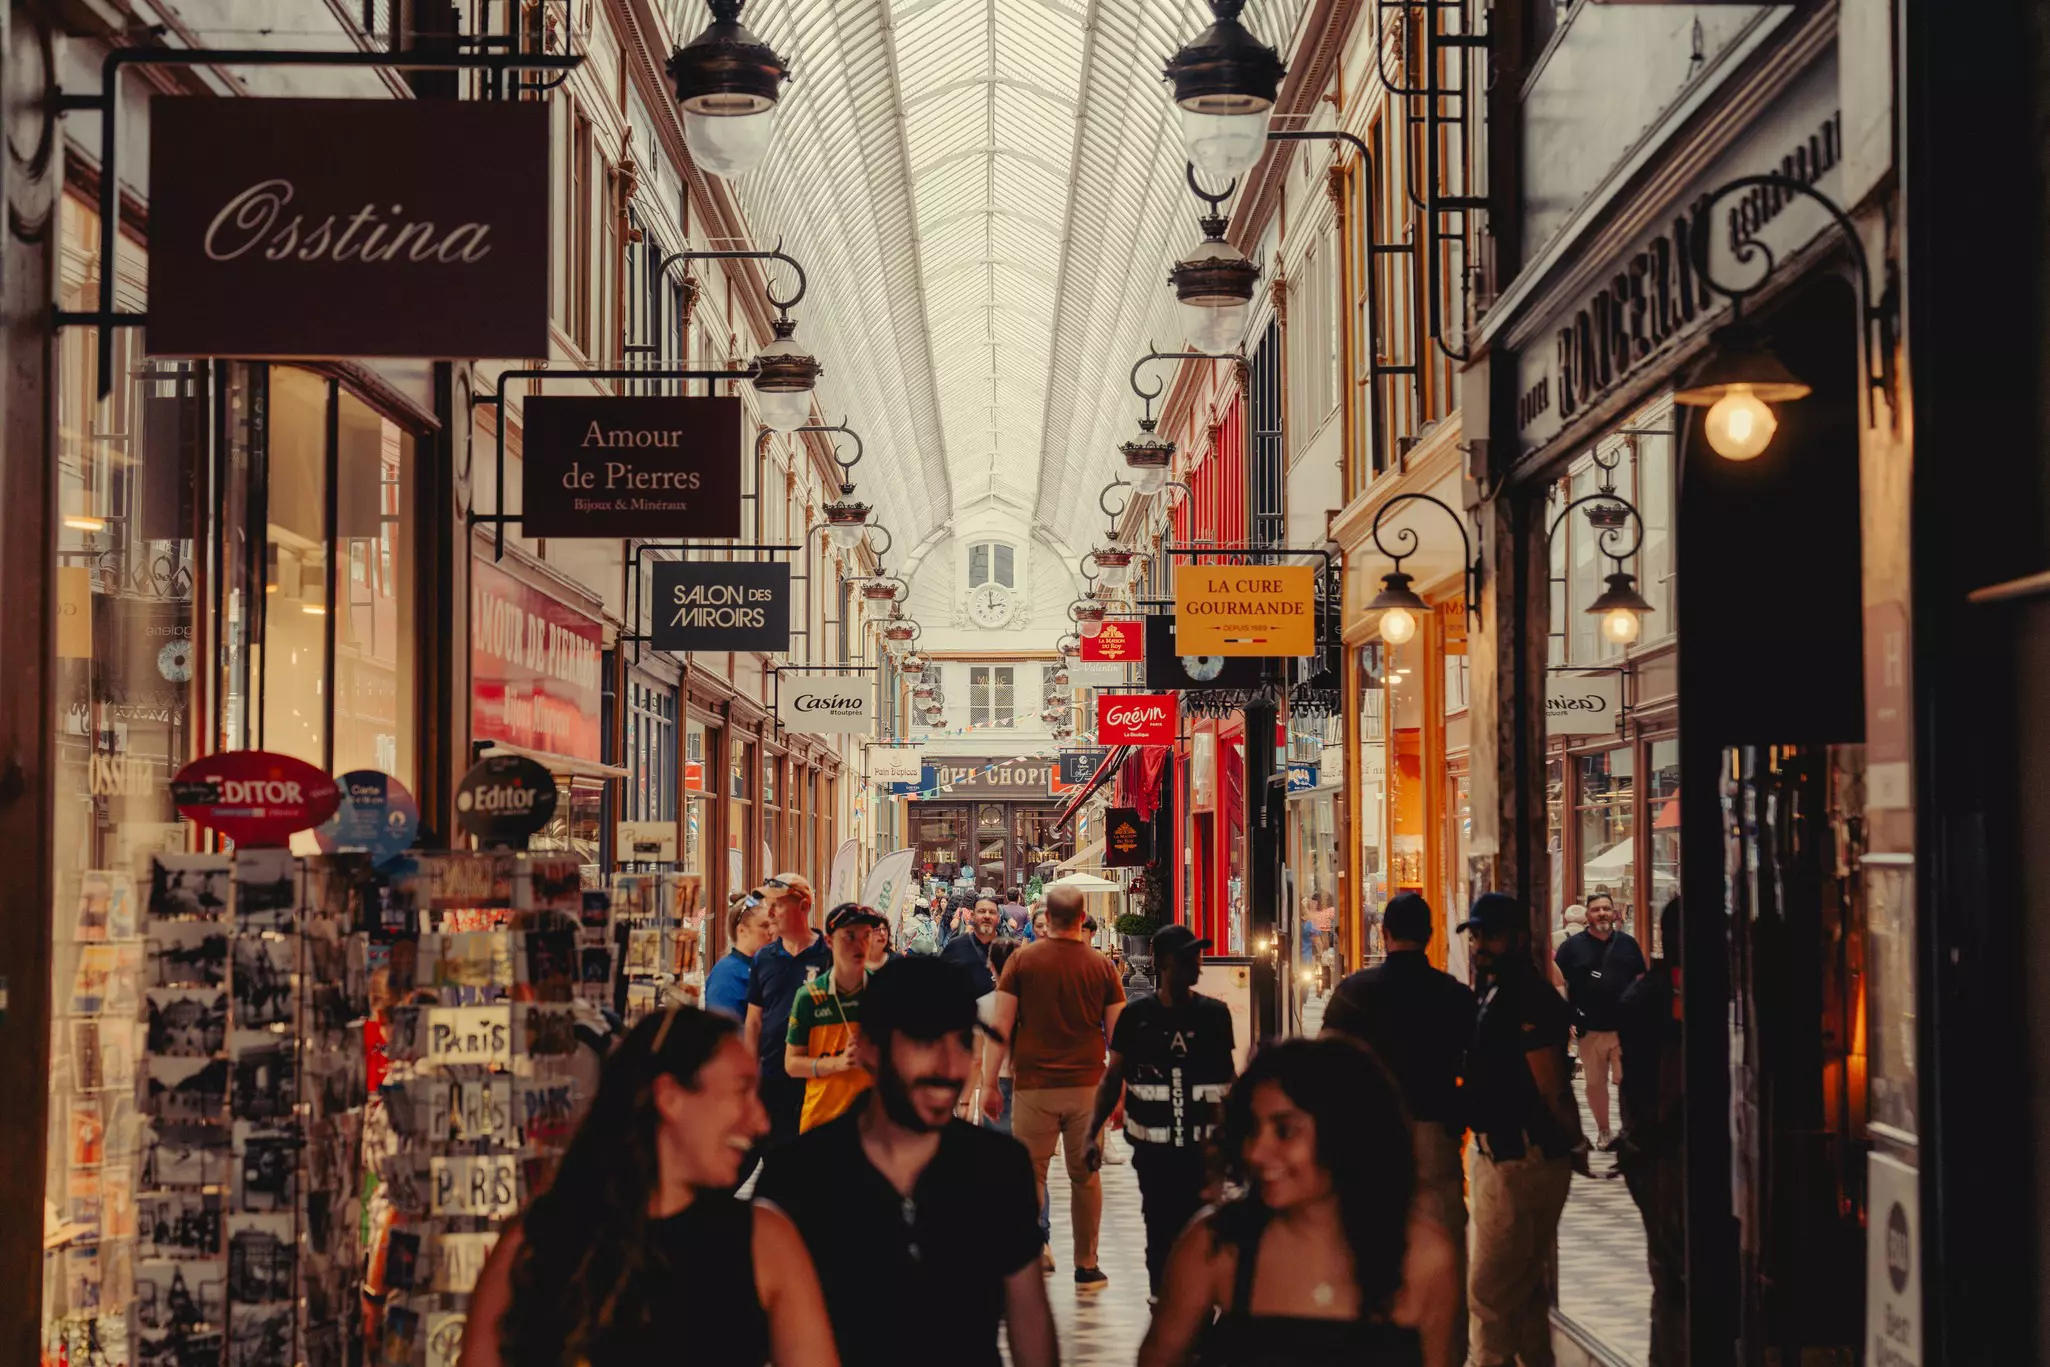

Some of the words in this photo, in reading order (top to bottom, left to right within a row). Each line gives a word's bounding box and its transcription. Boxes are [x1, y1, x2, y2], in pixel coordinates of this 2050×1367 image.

[204, 178, 491, 263] Osstina
[580, 420, 683, 448] Amour
[562, 462, 596, 489] de
[604, 462, 701, 489] Pierres
[574, 498, 612, 513] Bijoux
[615, 499, 628, 510] &
[630, 497, 687, 511] Minéraux
[673, 585, 744, 605] SALON
[748, 589, 772, 601] DES
[1208, 580, 1230, 593] LA
[1235, 579, 1283, 594] CURE
[670, 607, 765, 628] MIROIRS
[1186, 601, 1304, 615] GOURMANDE
[794, 694, 863, 712] Casino
[830, 709, 863, 717] #toutprès
[940, 765, 977, 785] ÔTEL
[985, 766, 1047, 786] CHOPI
